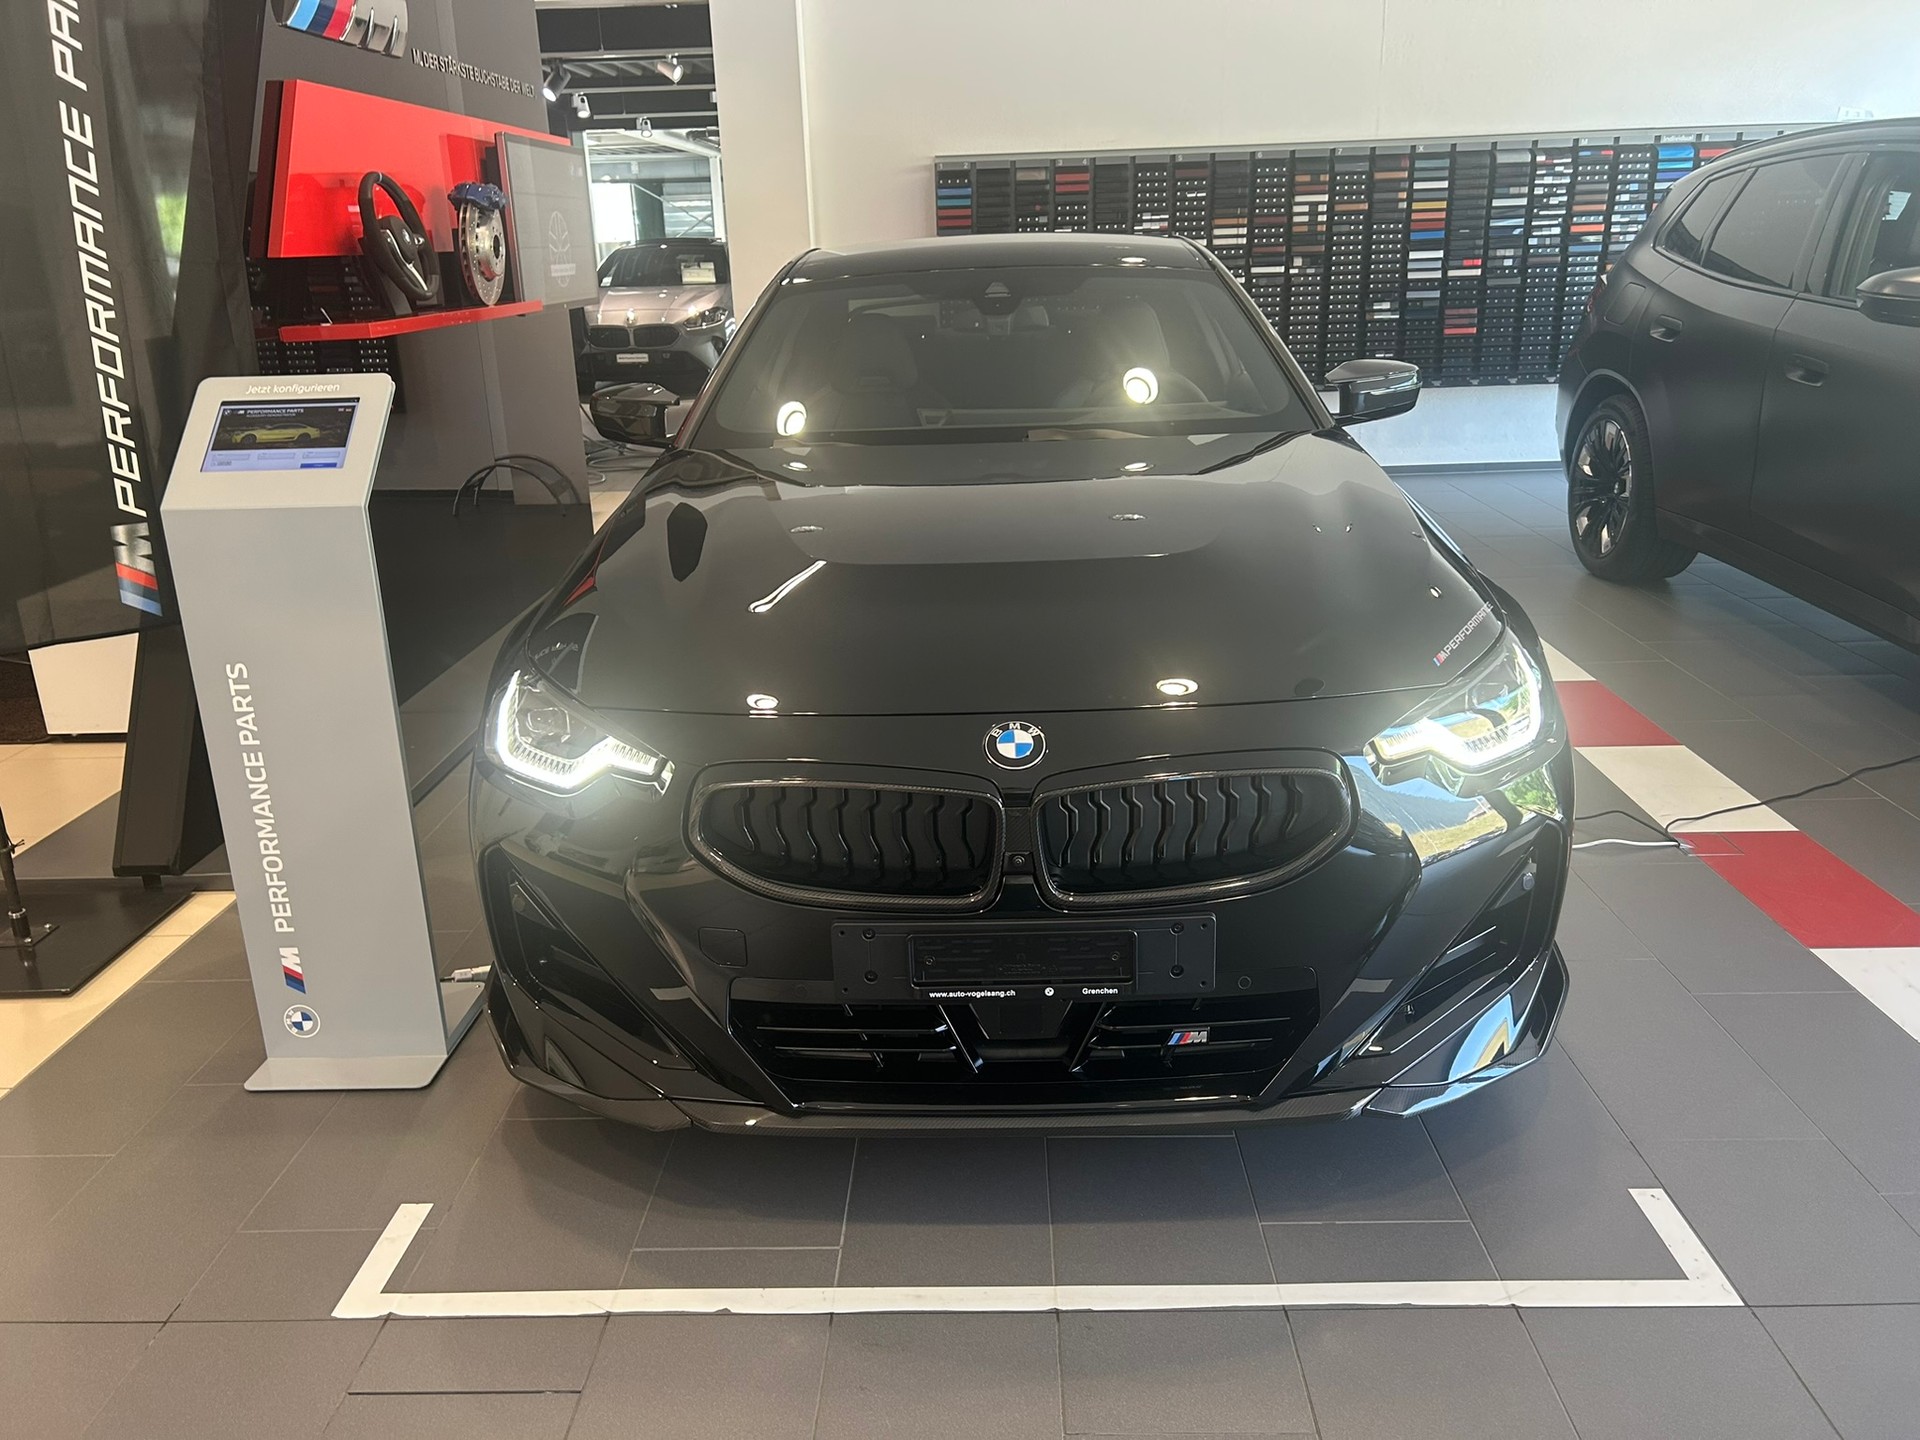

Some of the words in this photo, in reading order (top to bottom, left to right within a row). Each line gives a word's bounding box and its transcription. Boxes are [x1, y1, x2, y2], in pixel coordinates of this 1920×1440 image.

[47, 0, 88, 92] PA
[424, 51, 440, 71] DER
[58, 100, 148, 518] PERFORMANCE
[245, 385, 271, 395] Jetzt
[273, 383, 340, 394] konfigurieren
[225, 661, 261, 746] PARTS
[243, 751, 295, 932] PERFORMANCE
[929, 989, 1016, 999] www.auto-vogelsang.ch
[1082, 987, 1118, 995] Grenchen
